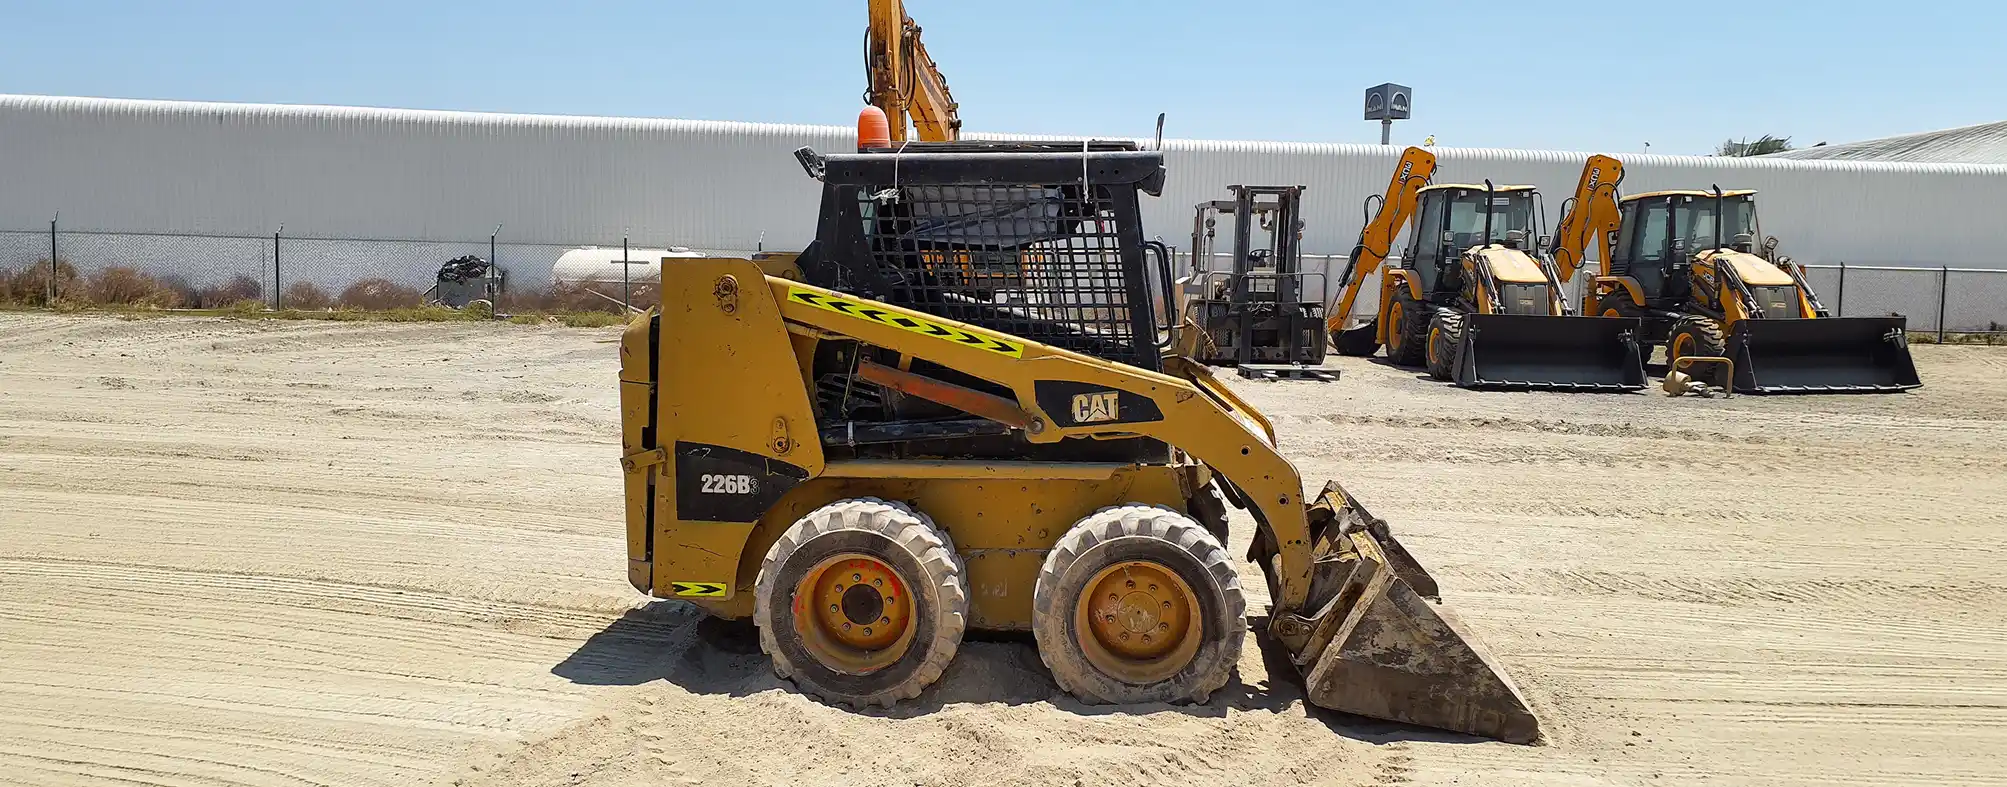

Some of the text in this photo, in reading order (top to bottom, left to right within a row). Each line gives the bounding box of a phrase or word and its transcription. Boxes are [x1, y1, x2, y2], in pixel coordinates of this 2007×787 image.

[1400, 161, 1413, 181] 3CX
[1588, 168, 1600, 187] 3CX
[1072, 391, 1119, 422] CAT
